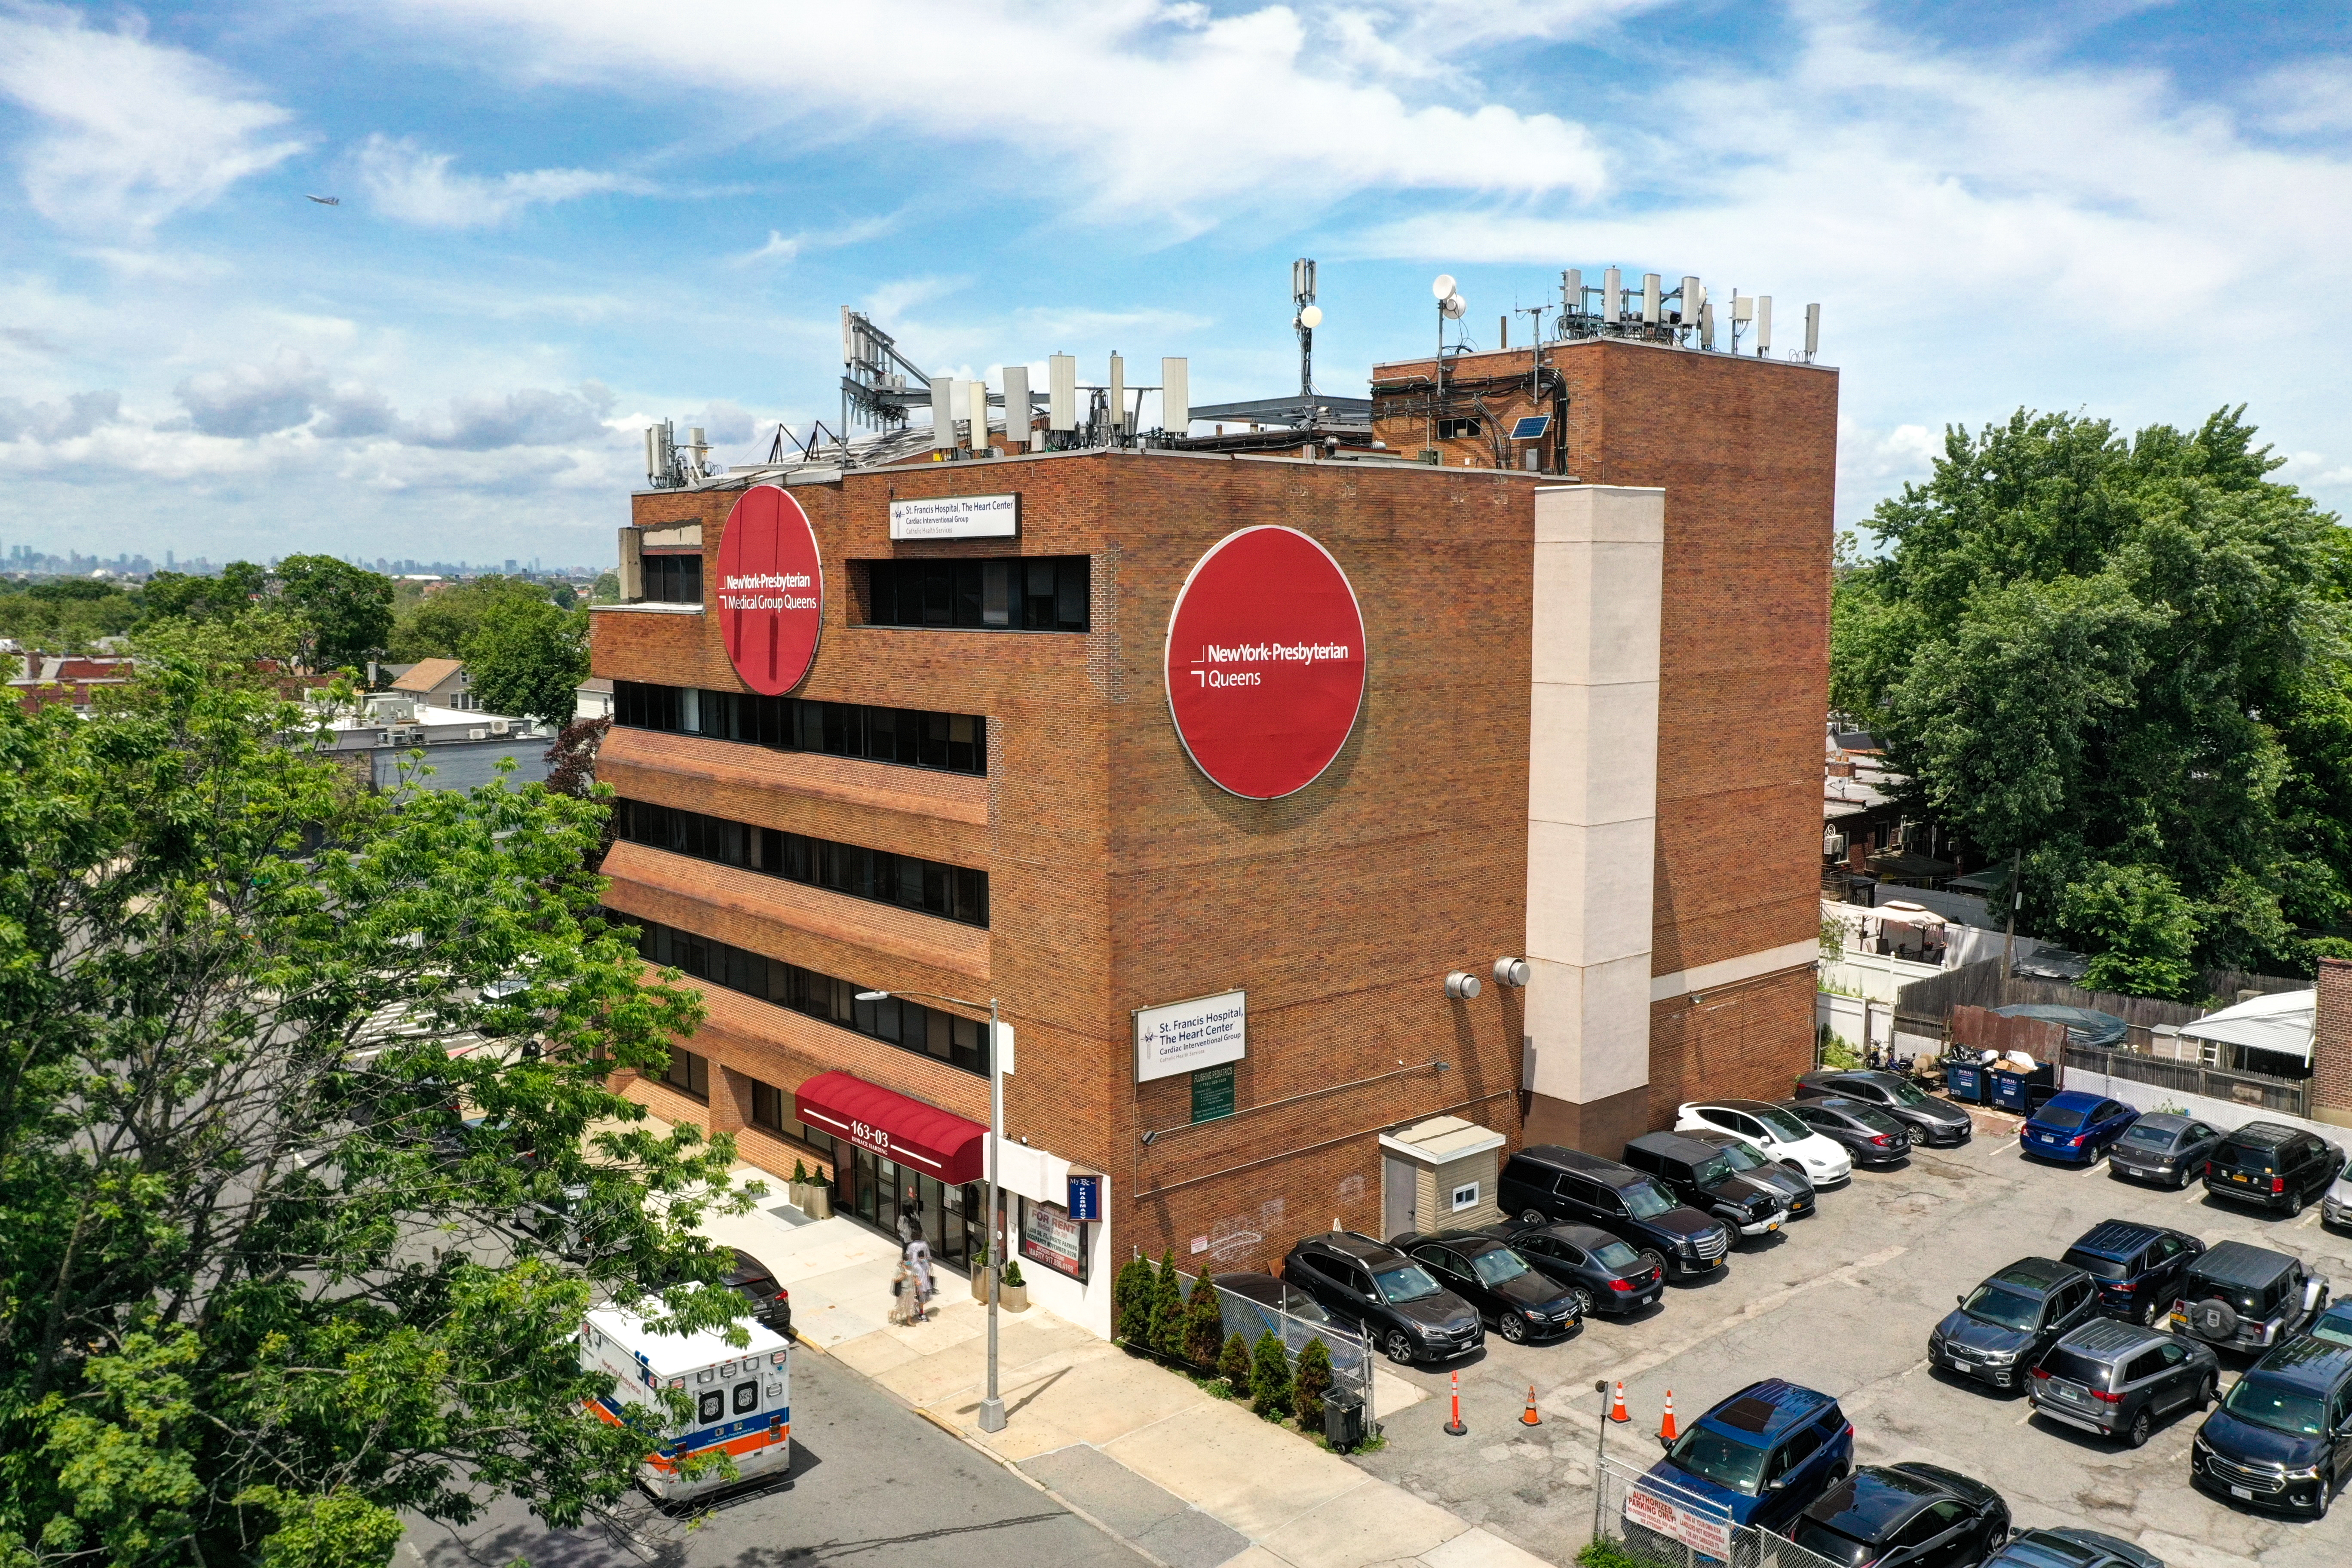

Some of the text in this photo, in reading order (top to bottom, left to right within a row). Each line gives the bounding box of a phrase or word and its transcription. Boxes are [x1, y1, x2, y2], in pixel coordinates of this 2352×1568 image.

[914, 505, 933, 514] Francis
[935, 503, 960, 515] Hospital,
[962, 503, 972, 512] The
[974, 502, 990, 511] Heart
[993, 500, 1013, 510] Center
[954, 516, 969, 524] Group
[727, 572, 810, 592] NewYork-Presbyterian
[728, 594, 816, 613] Medical Group Queens
[1208, 641, 1348, 666] NewYork-Presbyterian
[1208, 670, 1261, 688] Queens
[1159, 1006, 1243, 1033] St. Francis Hospital,
[1159, 1022, 1233, 1045] The Heart Center
[1159, 1033, 1241, 1055] Cardiac Interventional Group
[1159, 1055, 1175, 1063] Catholic
[1194, 1067, 1232, 1083] FLUSHING PEDIATRICS
[851, 1120, 889, 1148] 163-03
[852, 1135, 888, 1155] HORACE HARDING
[1032, 1209, 1049, 1224] FOR
[1052, 1217, 1076, 1234] RENT
[1037, 1221, 1051, 1232] Medical
[1027, 1232, 1076, 1258] OCCUPANCY NOVEMBER 2020
[1049, 1235, 1061, 1245] ONSITE
[1062, 1240, 1078, 1251] PARKING
[1029, 1247, 1044, 1260] MARTY
[1036, 1246, 1065, 1262] BROKERS WELCOME
[708, 1427, 754, 1443] NewYork-Presbyterian
[1628, 1497, 1656, 1515] PARKING
[1633, 1491, 1672, 1514] AUTHORIZED
[1632, 1509, 1646, 1519] OVERSIZE
[1647, 1521, 1663, 1531] ATTENDANT
[1680, 1519, 1696, 1531] LANDLORD
[1703, 1530, 1725, 1543] RESPONSIBLE
[1696, 1519, 1705, 1528] YOUR
[1687, 1538, 1699, 1549] VEHICLE
[1711, 1549, 1729, 1560] CONTENTS
[1699, 1536, 1714, 1548] DAMAGES
